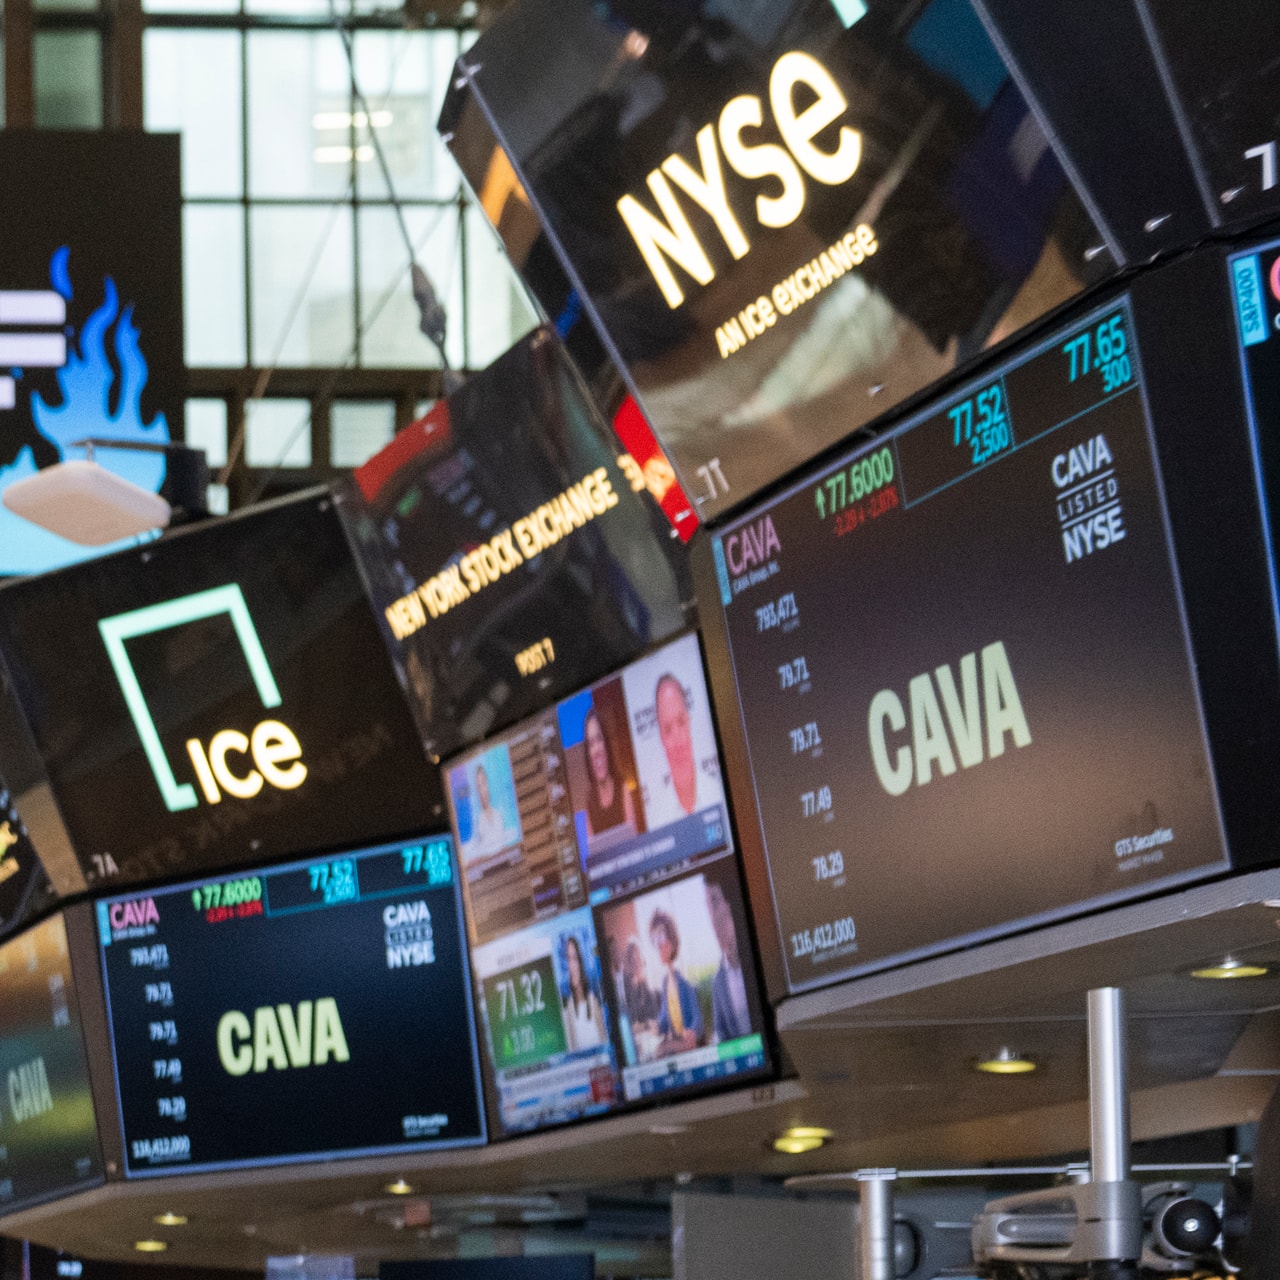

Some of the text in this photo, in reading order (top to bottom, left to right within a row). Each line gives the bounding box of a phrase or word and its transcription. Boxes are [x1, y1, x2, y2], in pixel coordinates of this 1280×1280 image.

[1063, 315, 1129, 383] 77.65
[1103, 357, 1131, 394] 300
[948, 386, 1005, 448] 77.52
[970, 422, 1009, 466] 2,500
[1052, 435, 1113, 489] CAVA
[825, 447, 893, 514] 77.6000
[1057, 478, 1118, 522] LISTED
[386, 465, 619, 641] NEW YORK STOCK EXCHANGE
[727, 514, 781, 575] CAVA
[1063, 513, 1126, 563] NYSE
[755, 594, 799, 632] 793,471
[778, 656, 810, 690] 79.71
[789, 721, 821, 754] 79.71
[868, 639, 1032, 797] CAVA
[801, 785, 832, 817] 77.49
[308, 859, 354, 891] 77.52
[812, 850, 844, 882] 78.29
[110, 897, 160, 930] CAVA
[383, 900, 431, 929] CAVA
[386, 939, 435, 970] NYSE
[791, 916, 856, 958] 116,412,000
[495, 970, 545, 1021] 71.32
[216, 996, 350, 1076] CAVA
